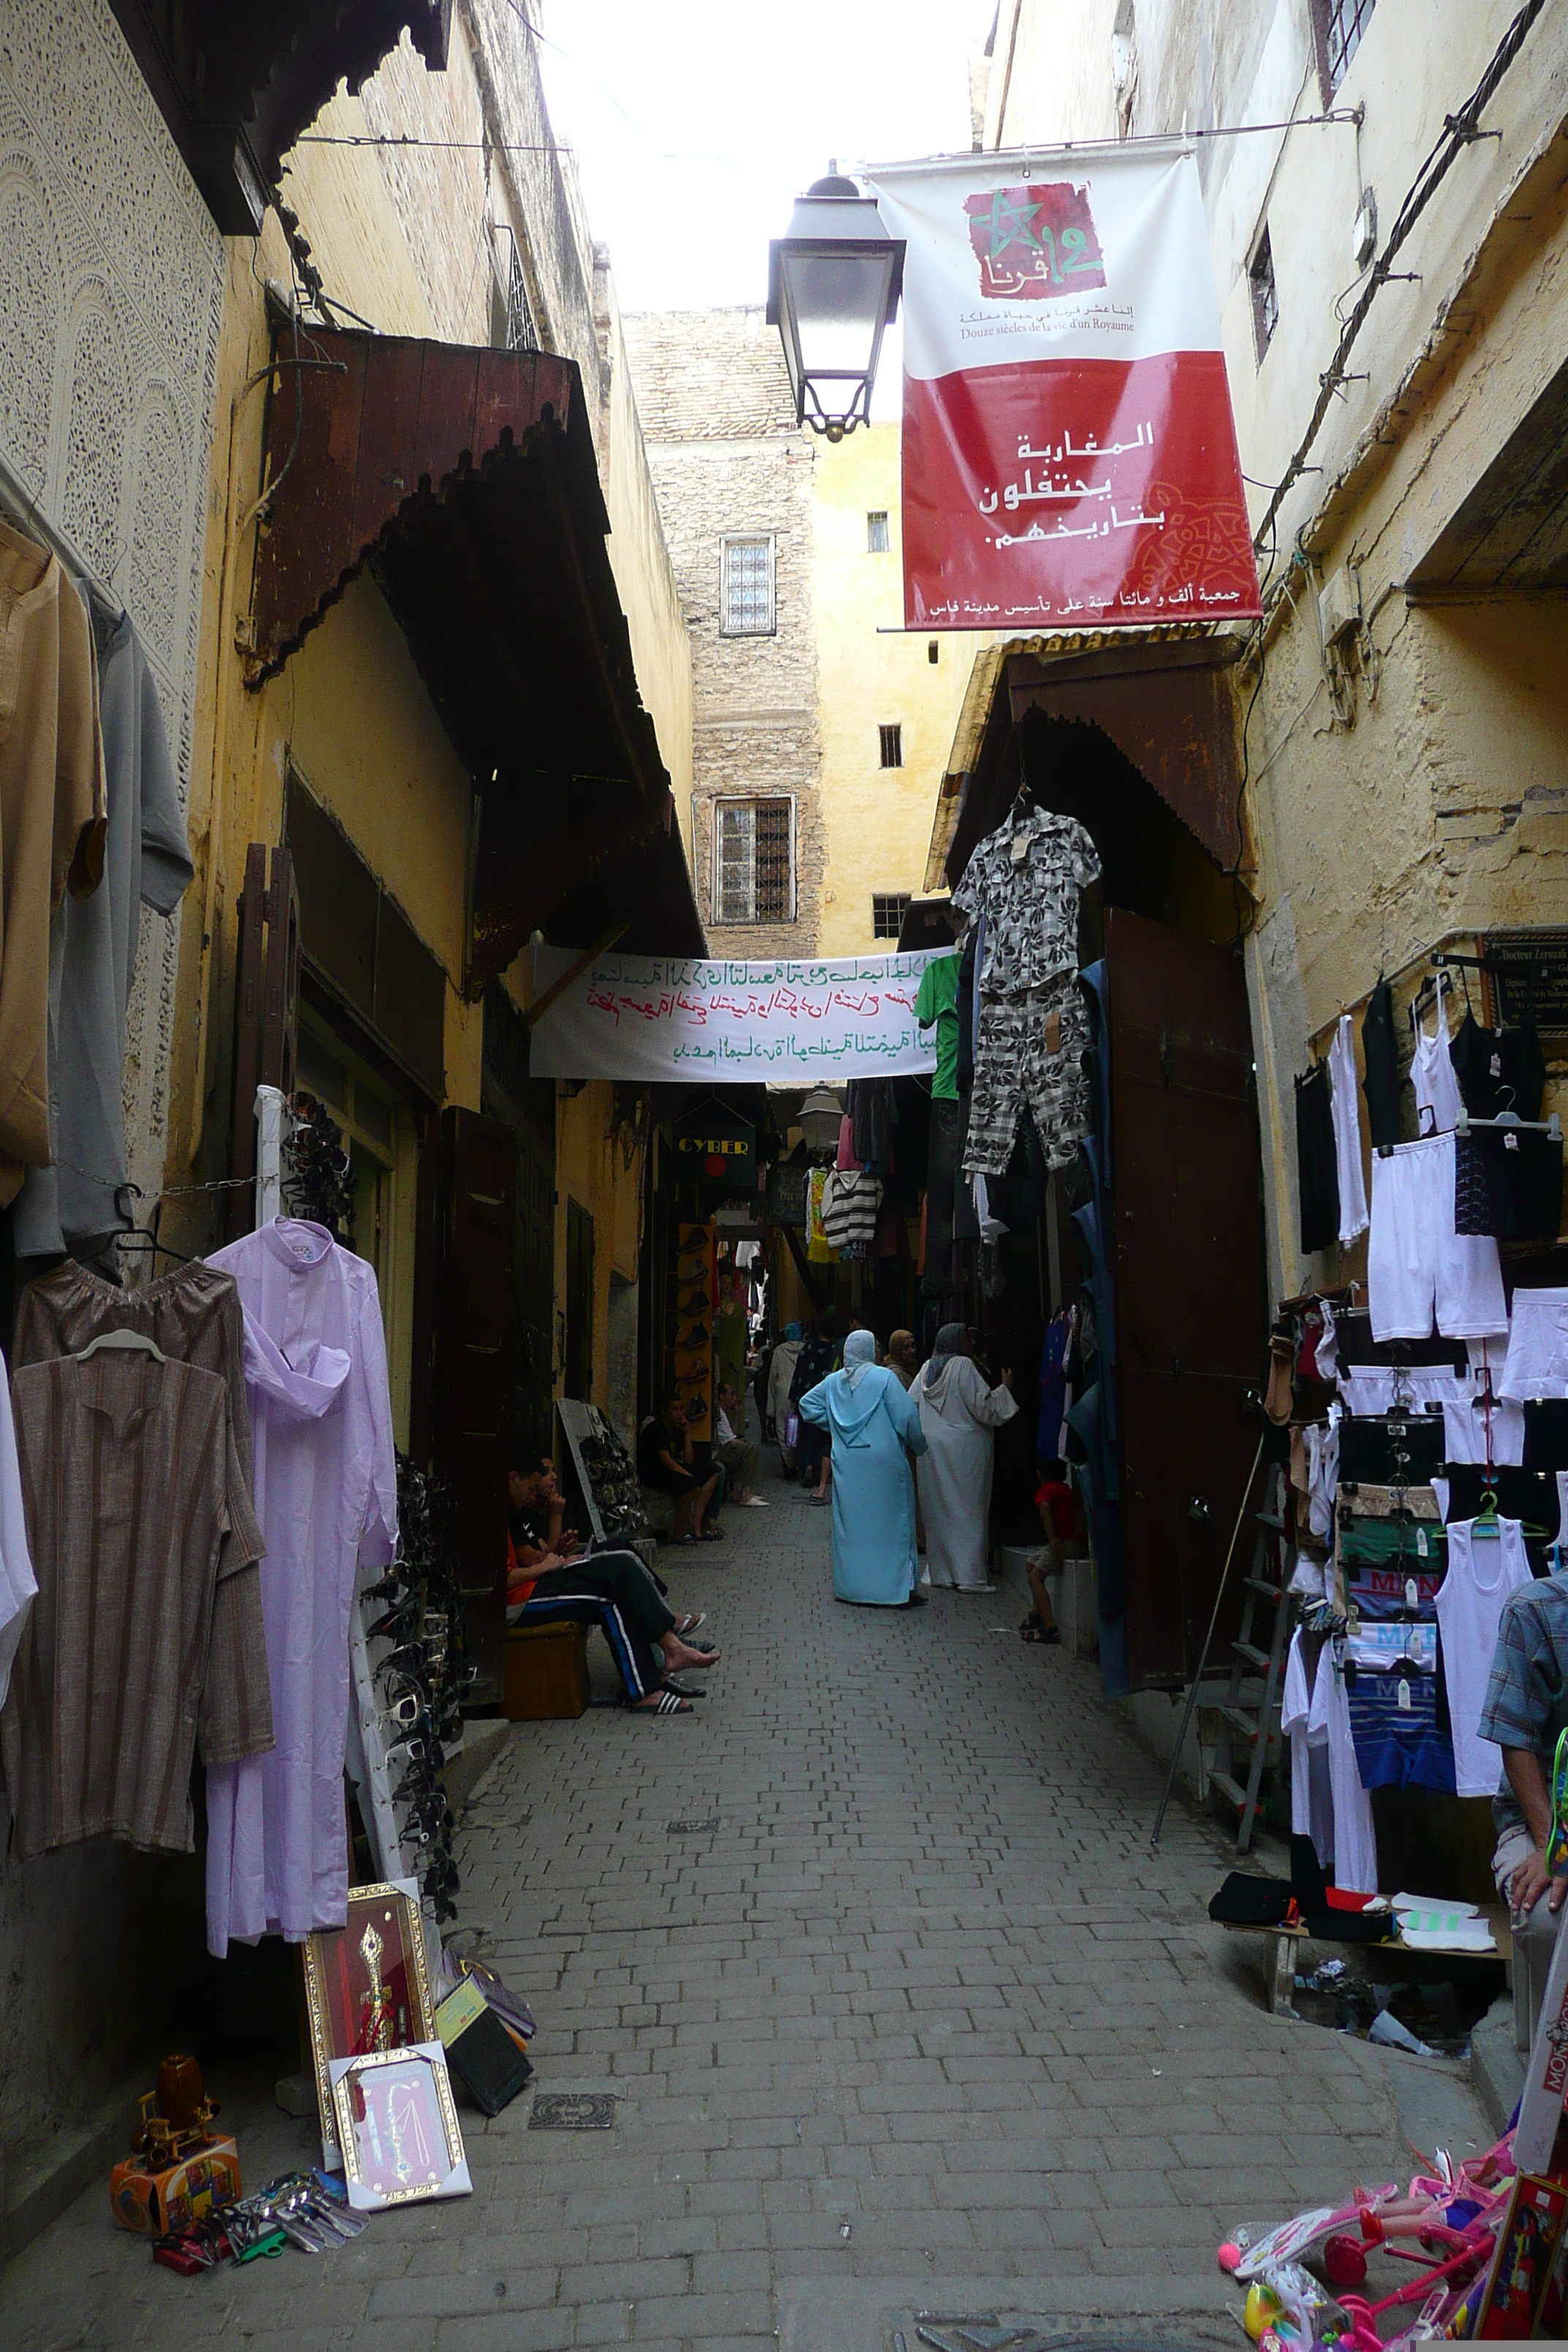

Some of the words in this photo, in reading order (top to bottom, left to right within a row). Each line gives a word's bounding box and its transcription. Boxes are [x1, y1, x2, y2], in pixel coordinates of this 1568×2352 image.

[984, 251, 1049, 294] قرنا
[1003, 309, 1033, 318] حياة
[1036, 310, 1050, 322] في
[1055, 305, 1080, 317] قرنا
[1084, 304, 1110, 315] عشر
[961, 327, 994, 339] Douze
[995, 321, 1028, 334] siècles
[1028, 322, 1040, 333] de
[1041, 322, 1051, 331] la
[1053, 321, 1067, 331] vie
[1069, 317, 1090, 328] d'un
[1093, 317, 1134, 333] Royaume
[1017, 420, 1154, 464] المغاربة
[979, 467, 1112, 513] يحتفلون
[1120, 590, 1150, 606] مائتا
[1169, 581, 1194, 603] ألف
[1199, 587, 1240, 604] جمعية
[930, 599, 959, 615] فاس
[964, 600, 1000, 614] مدينة
[1005, 595, 1051, 615] تأسيس
[1057, 598, 1084, 614] على
[1090, 595, 1114, 607] سنة
[1156, 595, 1164, 606] و
[1503, 949, 1532, 960] Docteur
[679, 1138, 748, 1155] CYBER
